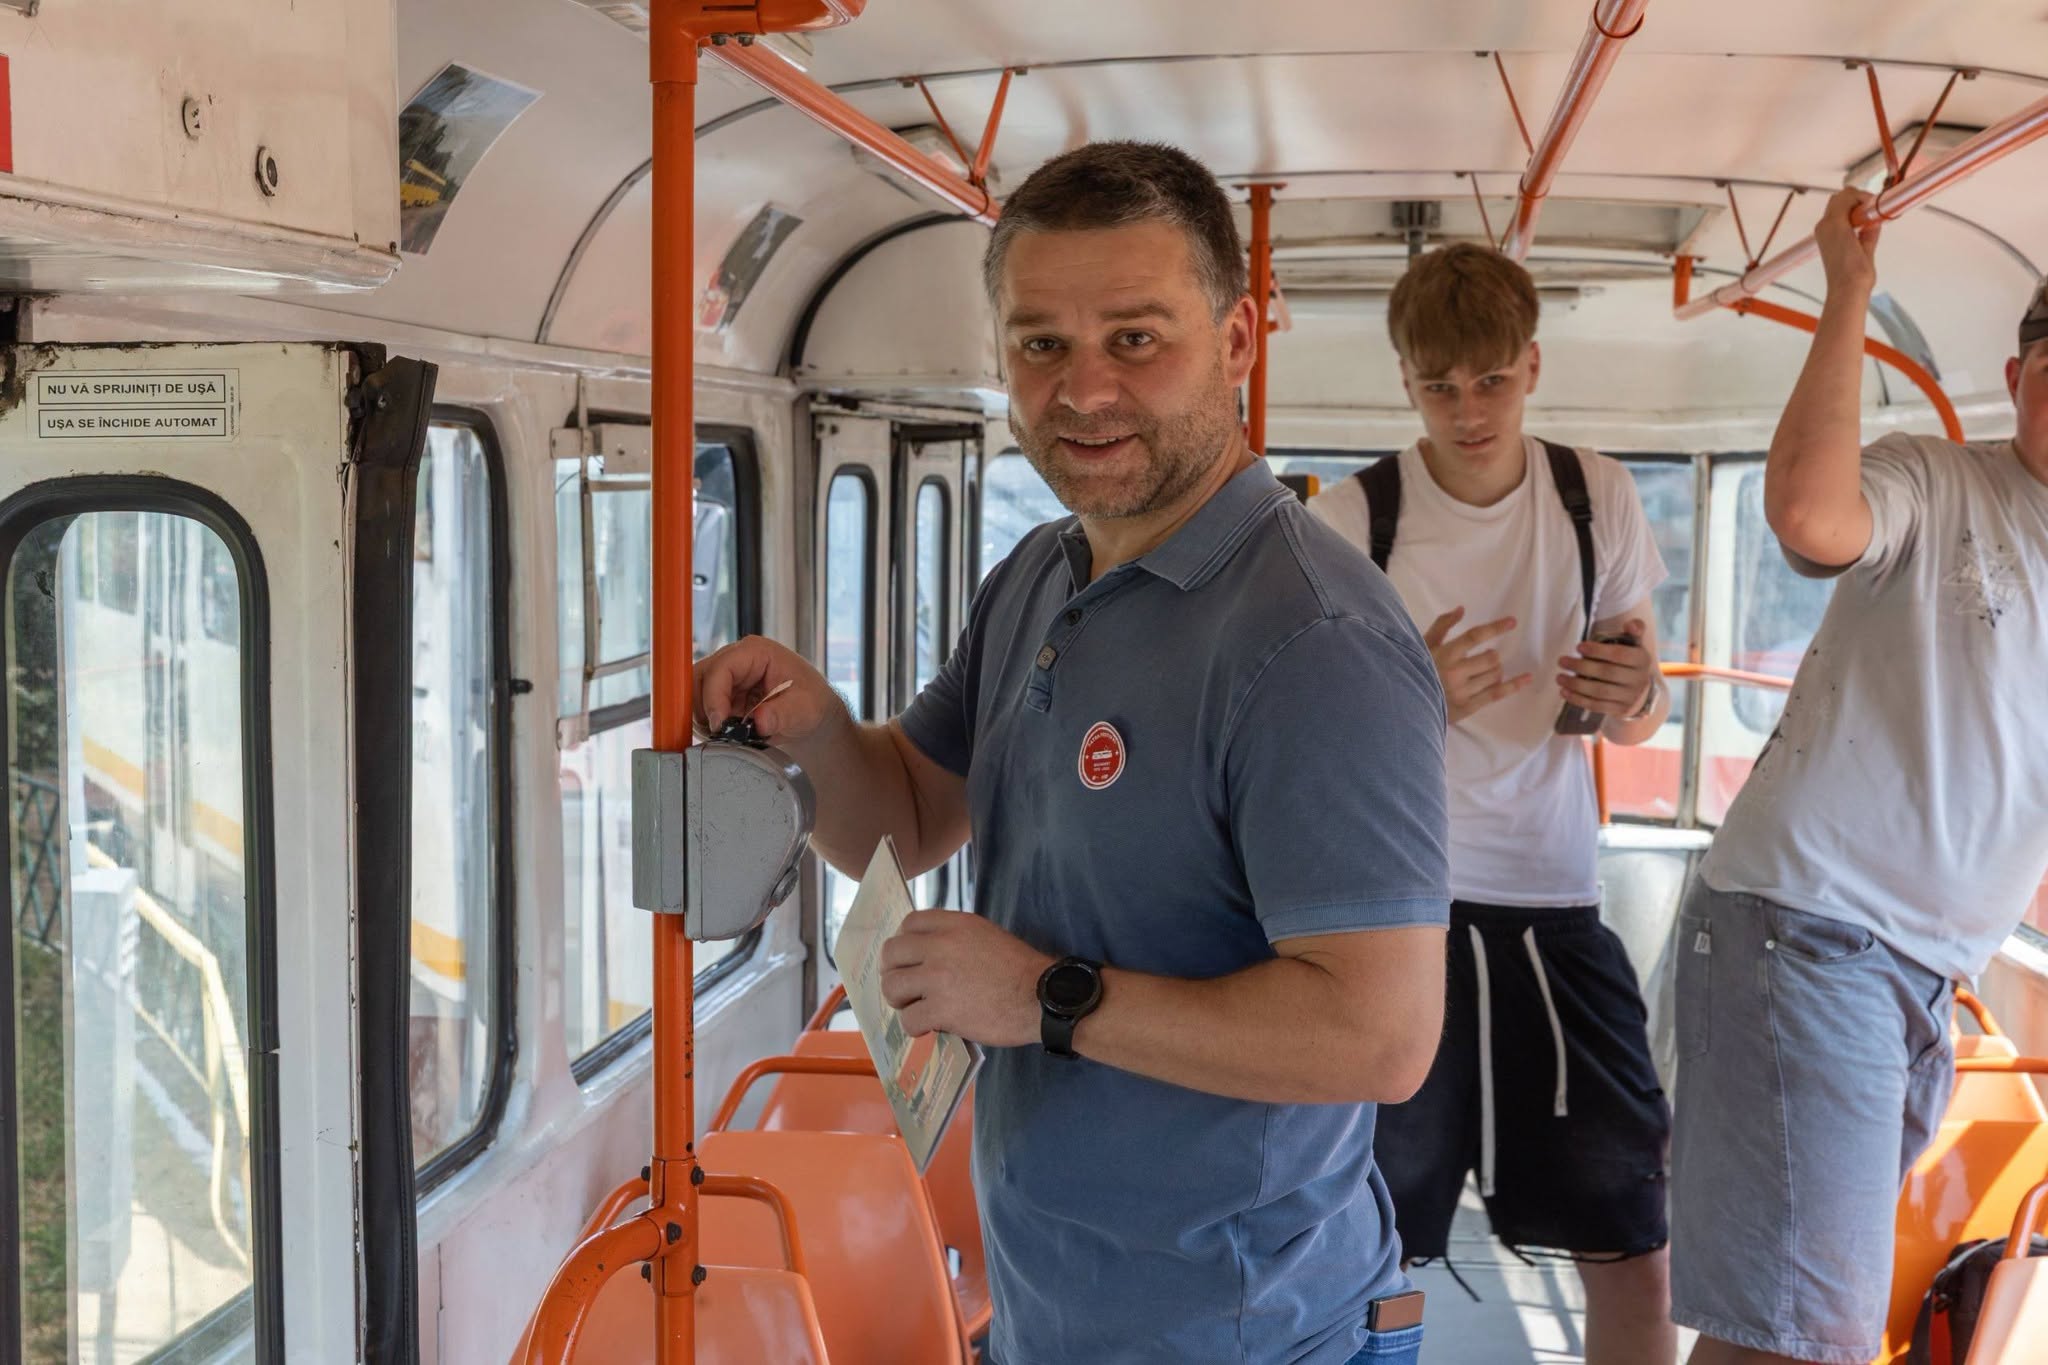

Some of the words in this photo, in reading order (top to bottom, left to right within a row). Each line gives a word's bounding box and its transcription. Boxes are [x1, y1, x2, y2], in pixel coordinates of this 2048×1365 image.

[47, 384, 67, 395] NU
[71, 382, 90, 394] VĂ
[165, 383, 184, 394] DE
[78, 418, 96, 429] SE
[98, 416, 152, 429] ÎNCHIDE
[154, 417, 218, 428] AUTOMAT
